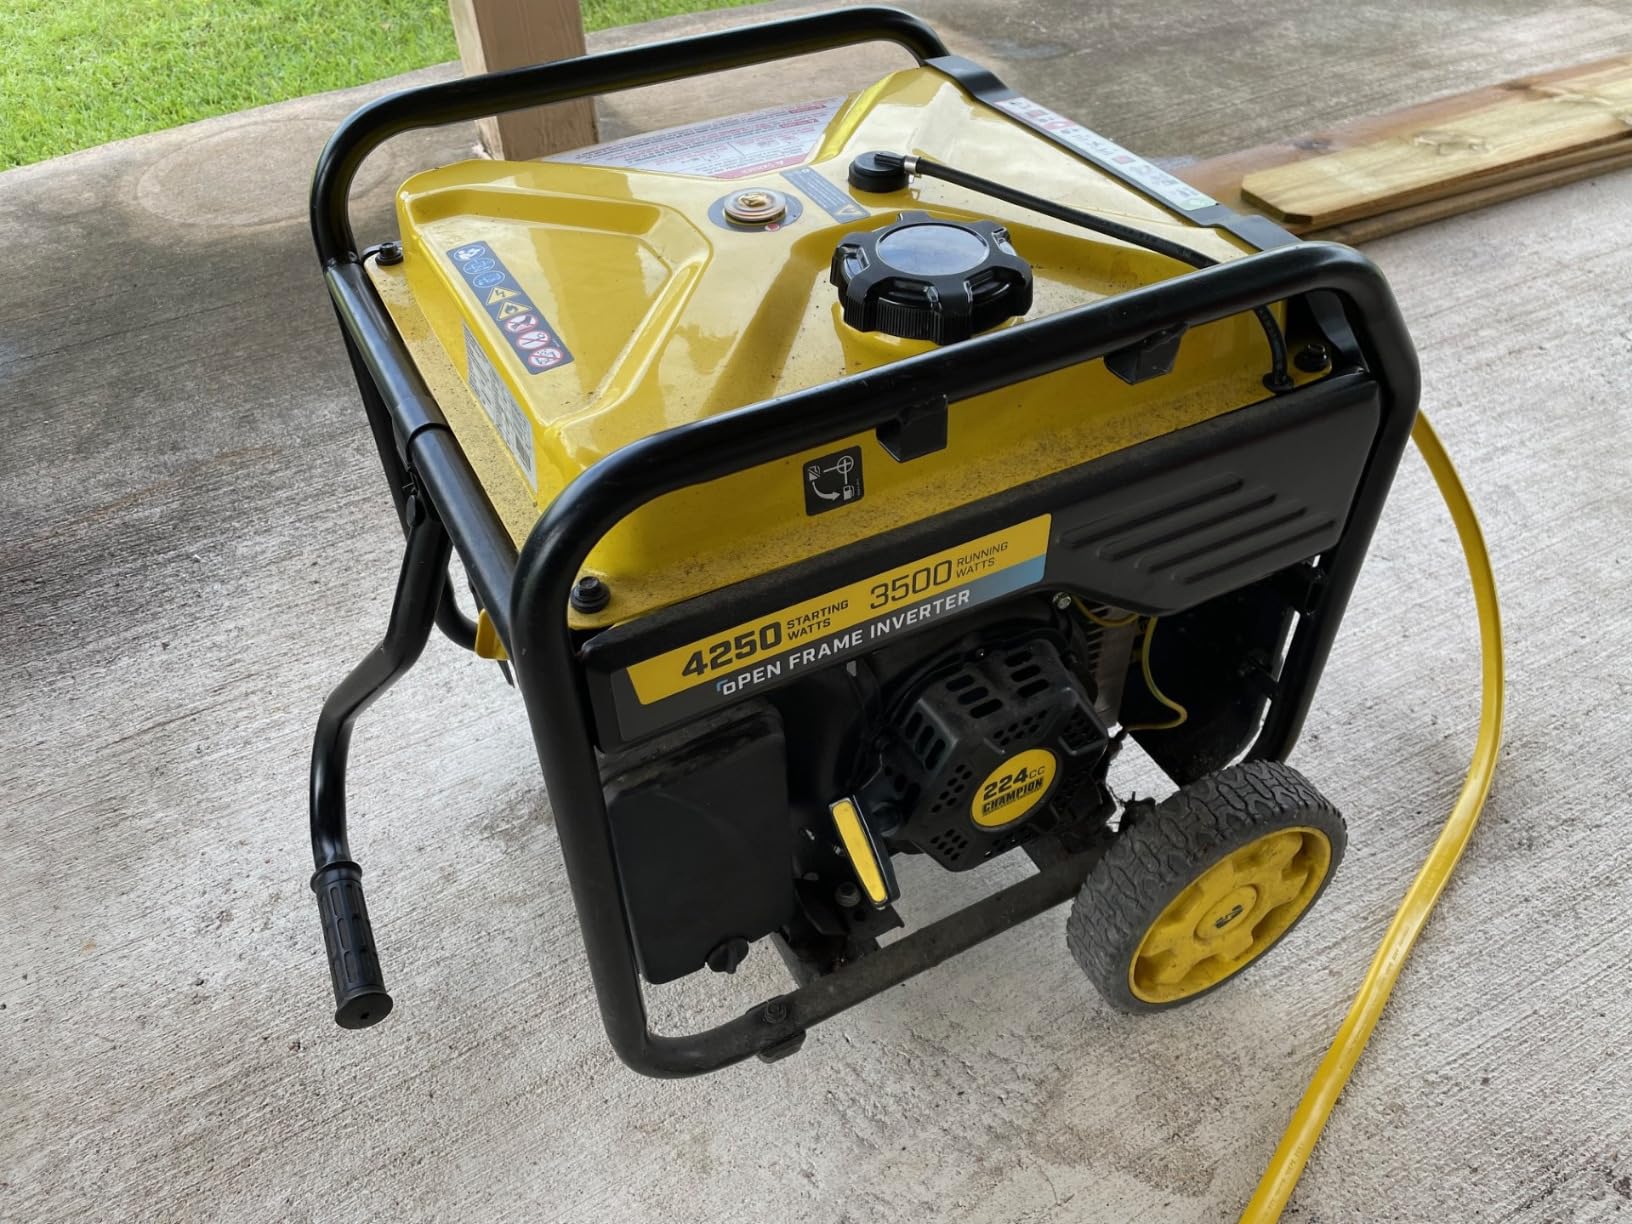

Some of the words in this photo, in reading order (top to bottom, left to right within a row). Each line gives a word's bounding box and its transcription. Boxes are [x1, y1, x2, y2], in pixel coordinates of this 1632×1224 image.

[870, 560, 952, 610] 3500
[956, 541, 1008, 567] RUNNING
[956, 557, 995, 578] WATTS
[681, 621, 782, 678] 4250
[787, 600, 849, 629] STARTING
[787, 618, 831, 641] WATTS
[789, 629, 863, 670] FRAME
[870, 589, 970, 639] INVERTER
[982, 777, 1043, 816] CHAMPION
